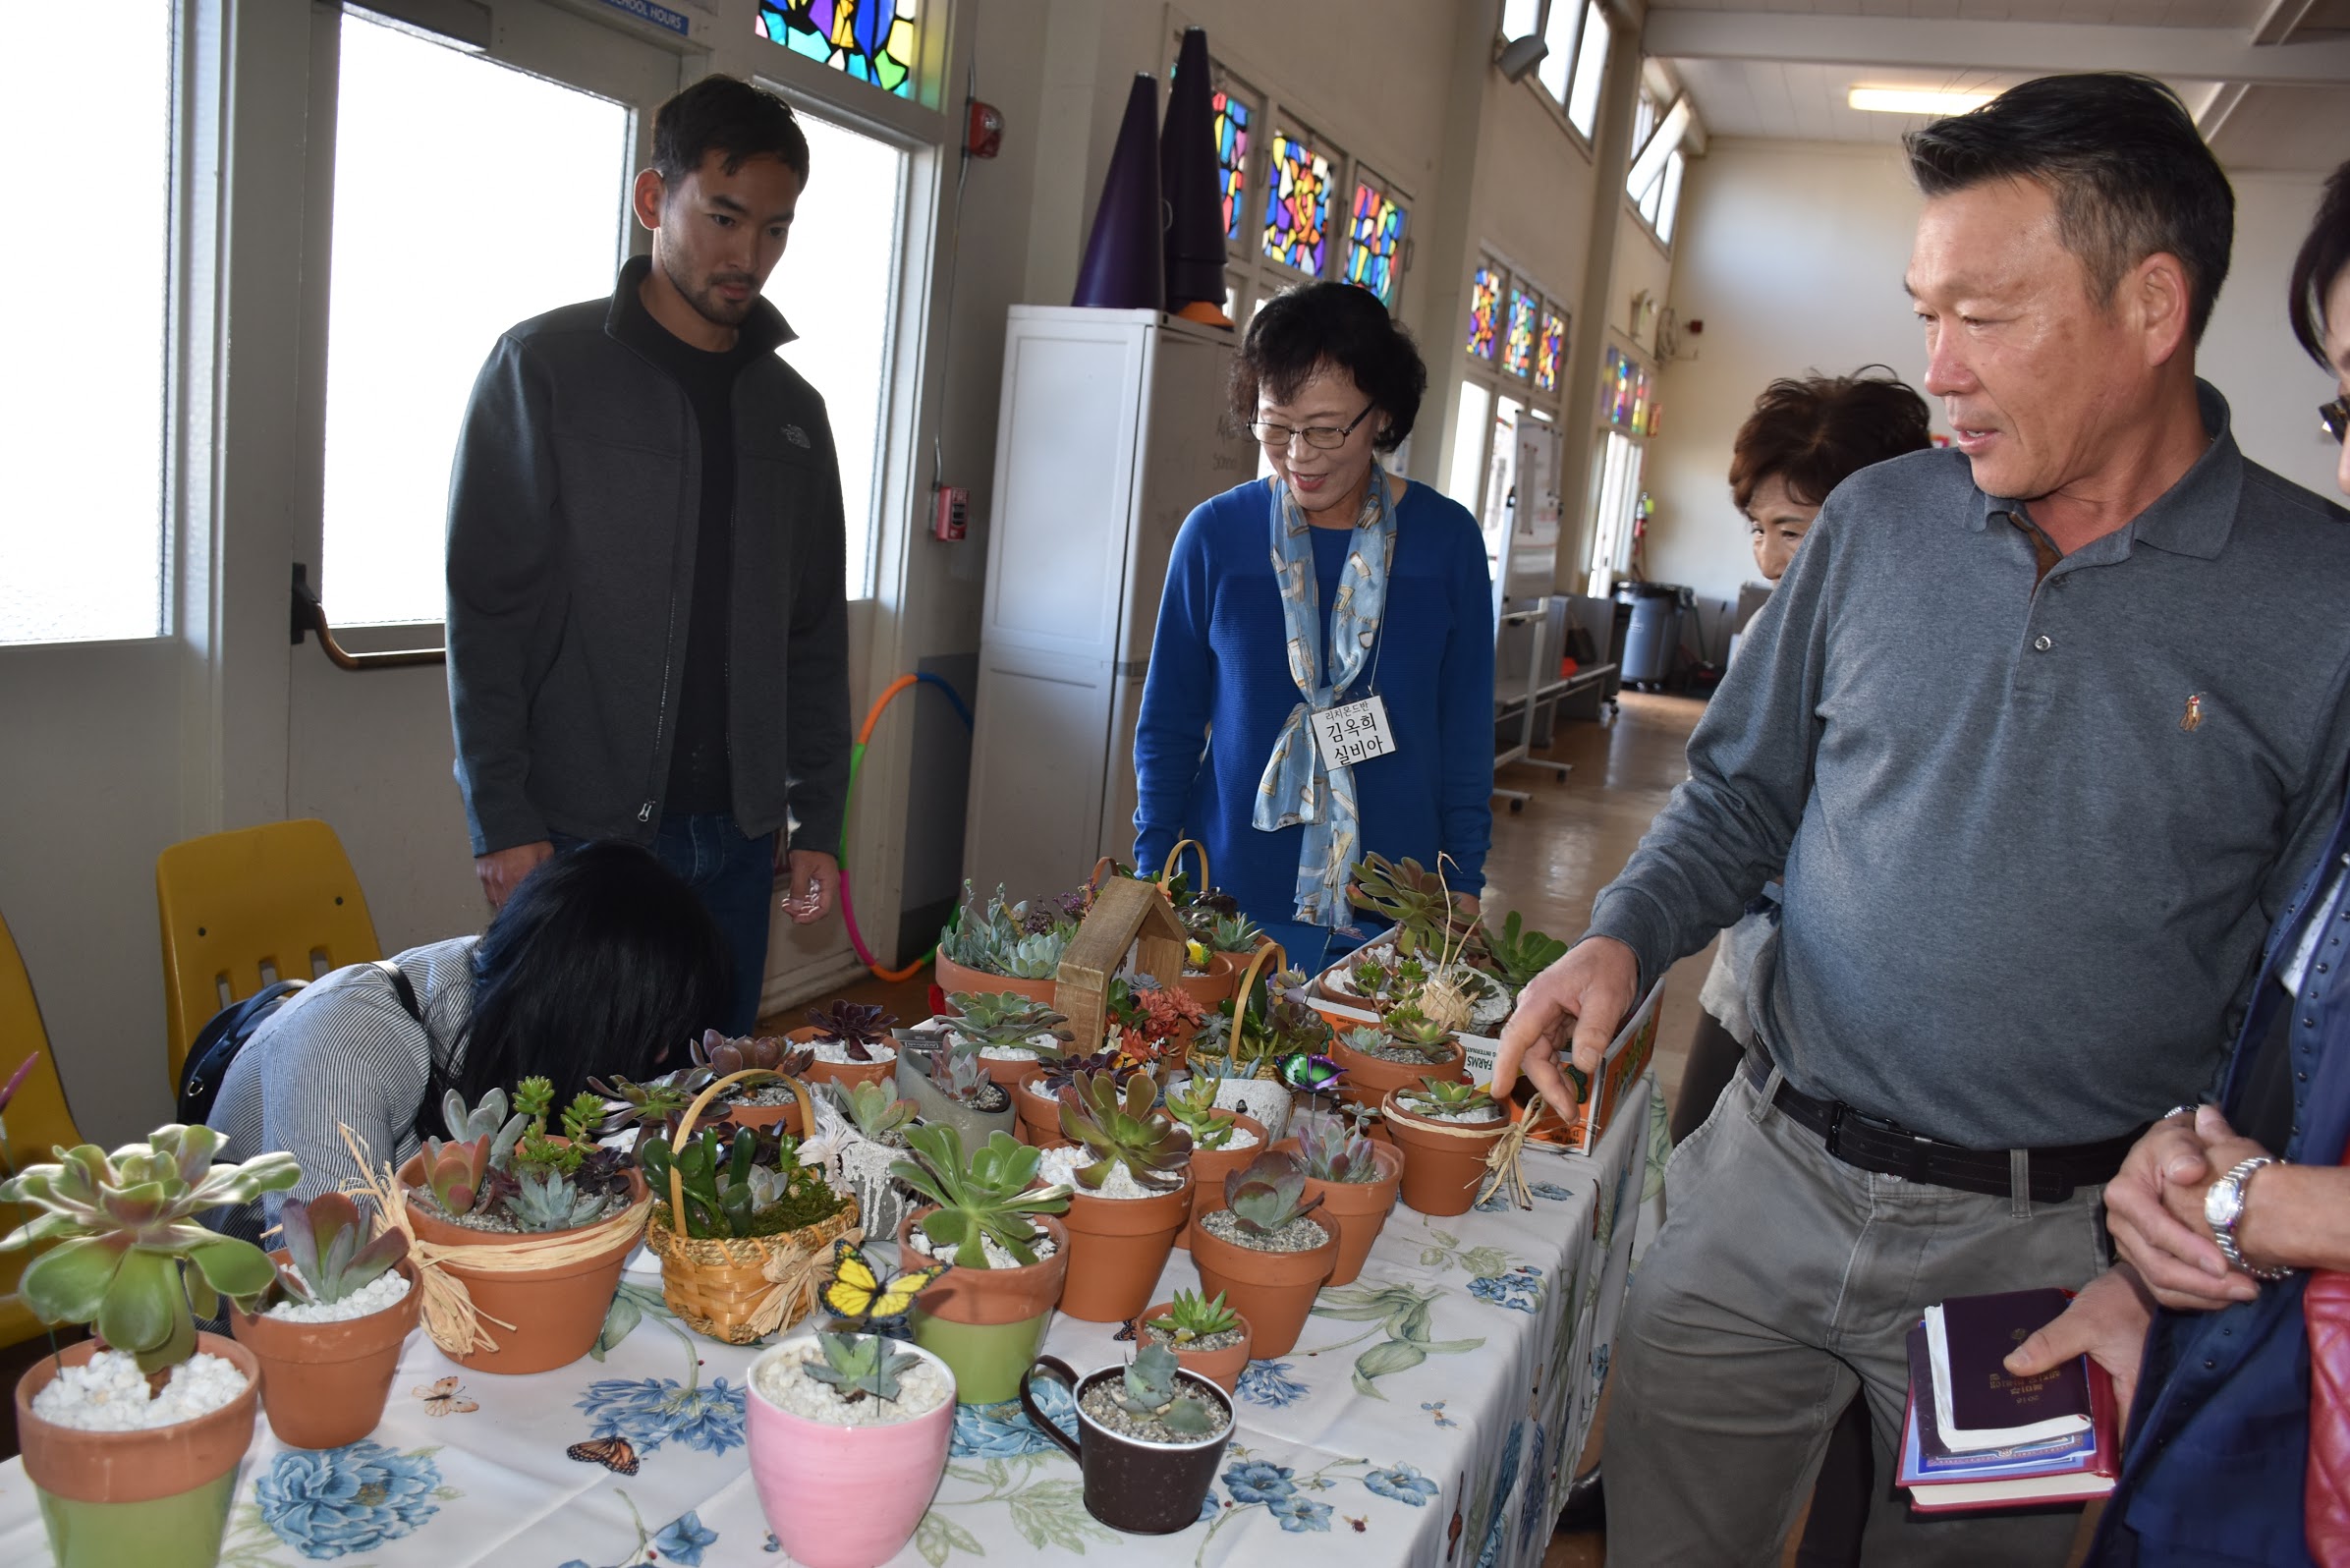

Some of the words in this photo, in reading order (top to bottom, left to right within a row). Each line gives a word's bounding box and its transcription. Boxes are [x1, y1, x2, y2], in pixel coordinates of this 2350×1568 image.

[611, 0, 648, 16] CHOOL
[650, 7, 682, 29] HOURS
[1326, 712, 1377, 743] 김옥희
[1335, 735, 1383, 766] 실비아
[1467, 1055, 1493, 1070] FARMS
